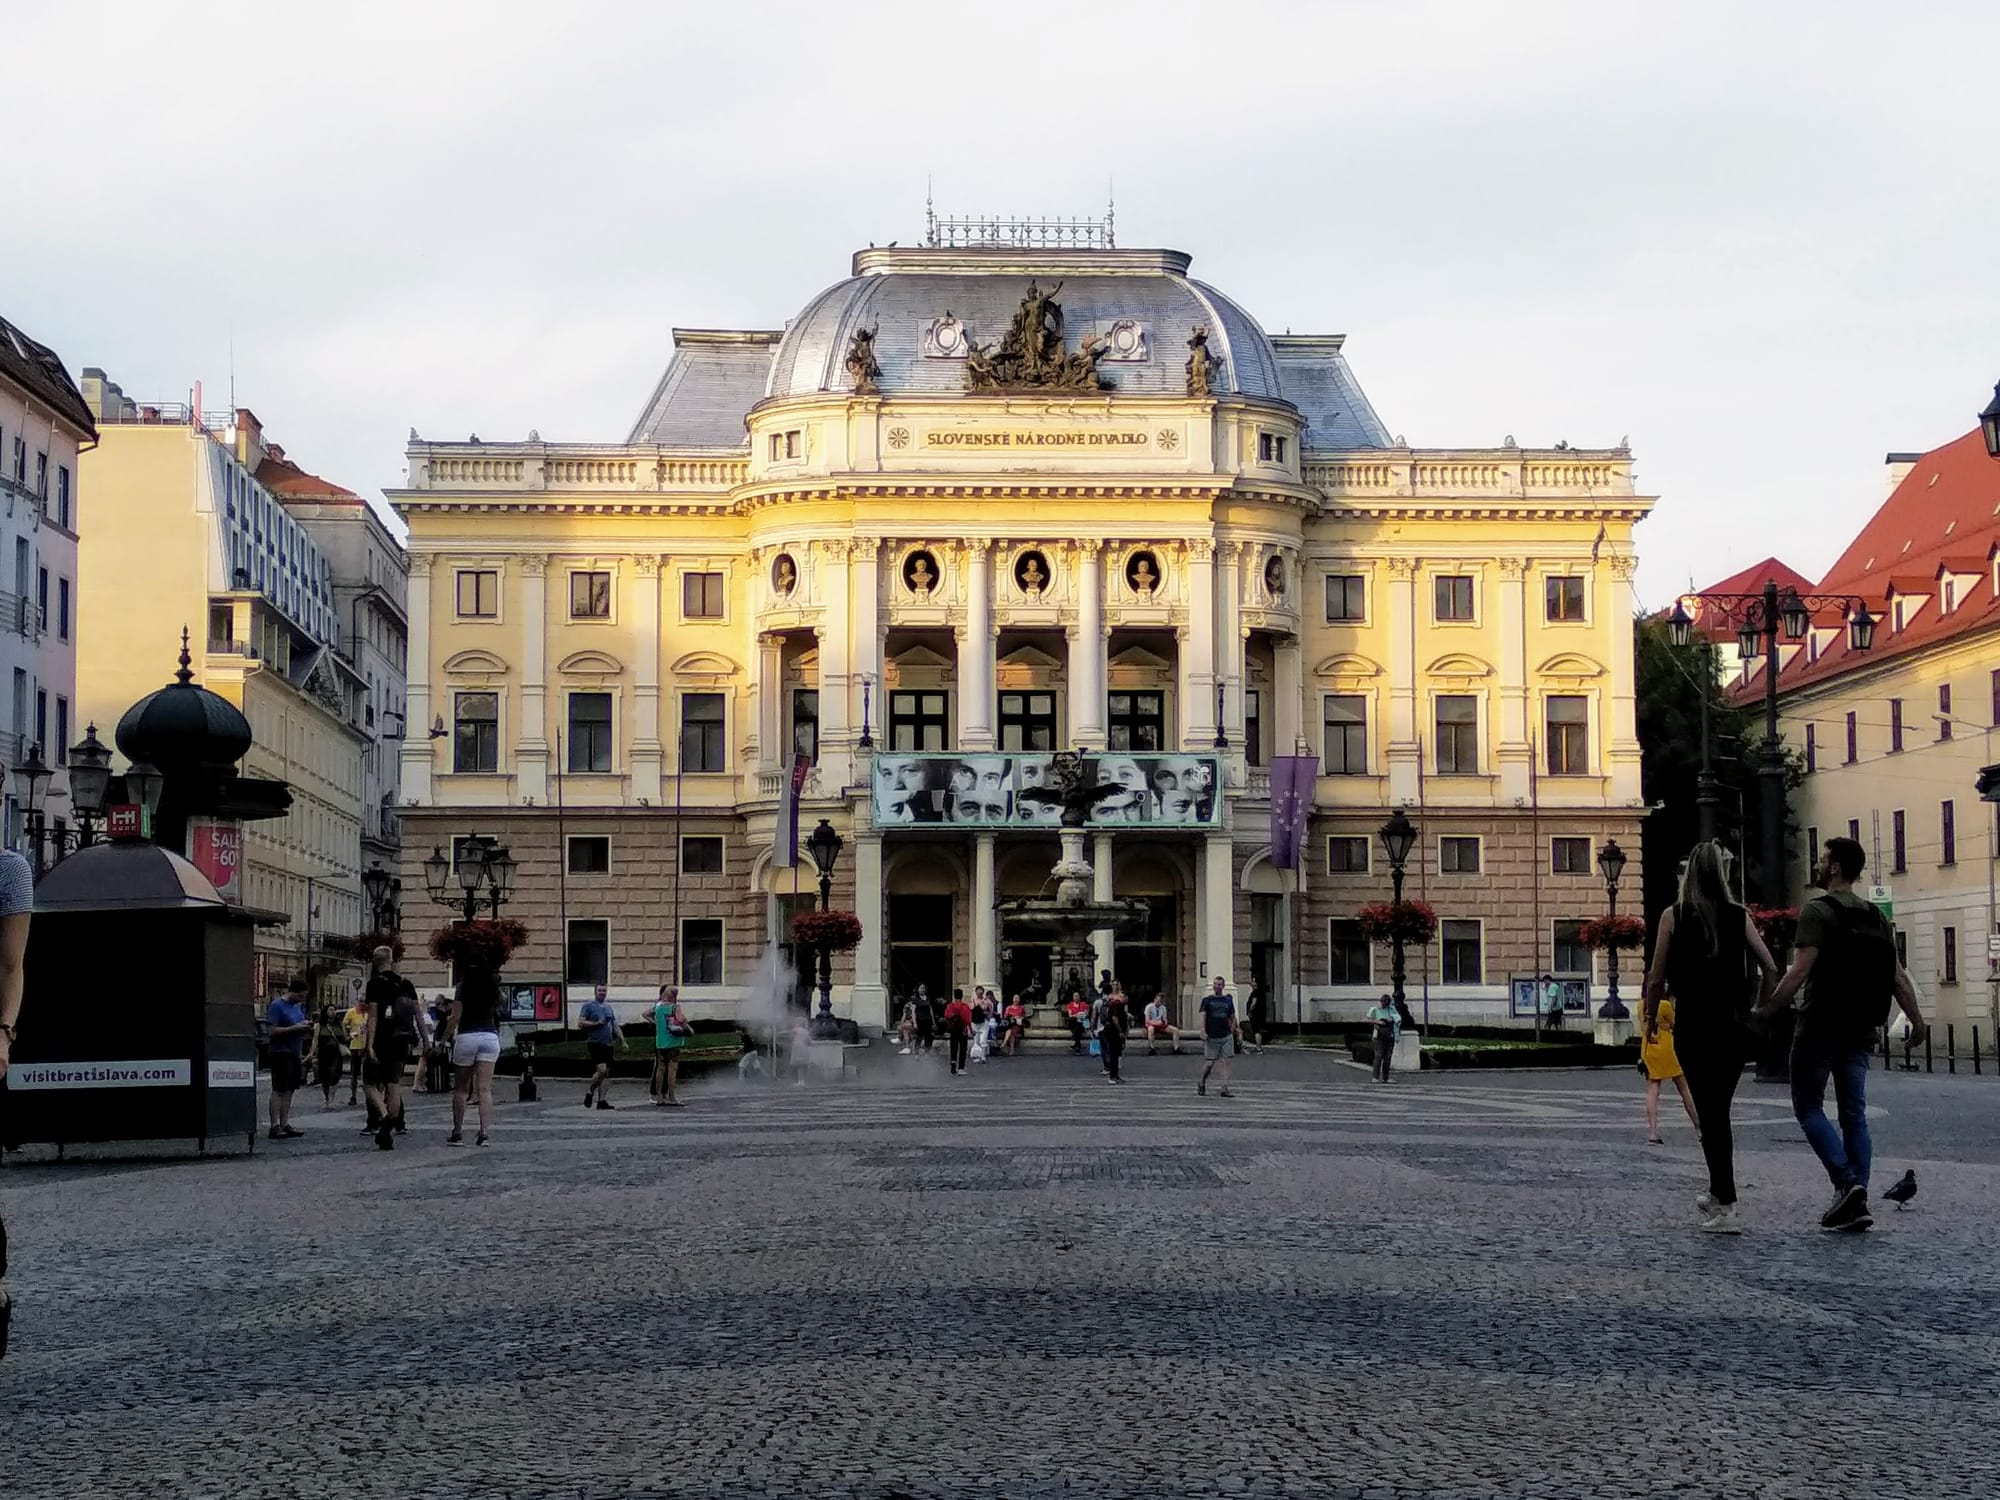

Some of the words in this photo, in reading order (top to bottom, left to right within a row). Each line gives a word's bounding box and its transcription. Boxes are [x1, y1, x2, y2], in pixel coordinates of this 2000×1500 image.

[927, 431, 1011, 446] SLOVENSKÉ
[1015, 431, 1086, 446] NÁRODNÉ
[1088, 432, 1148, 445] DIVADLO
[22, 1067, 176, 1083] visitbratislava.com
